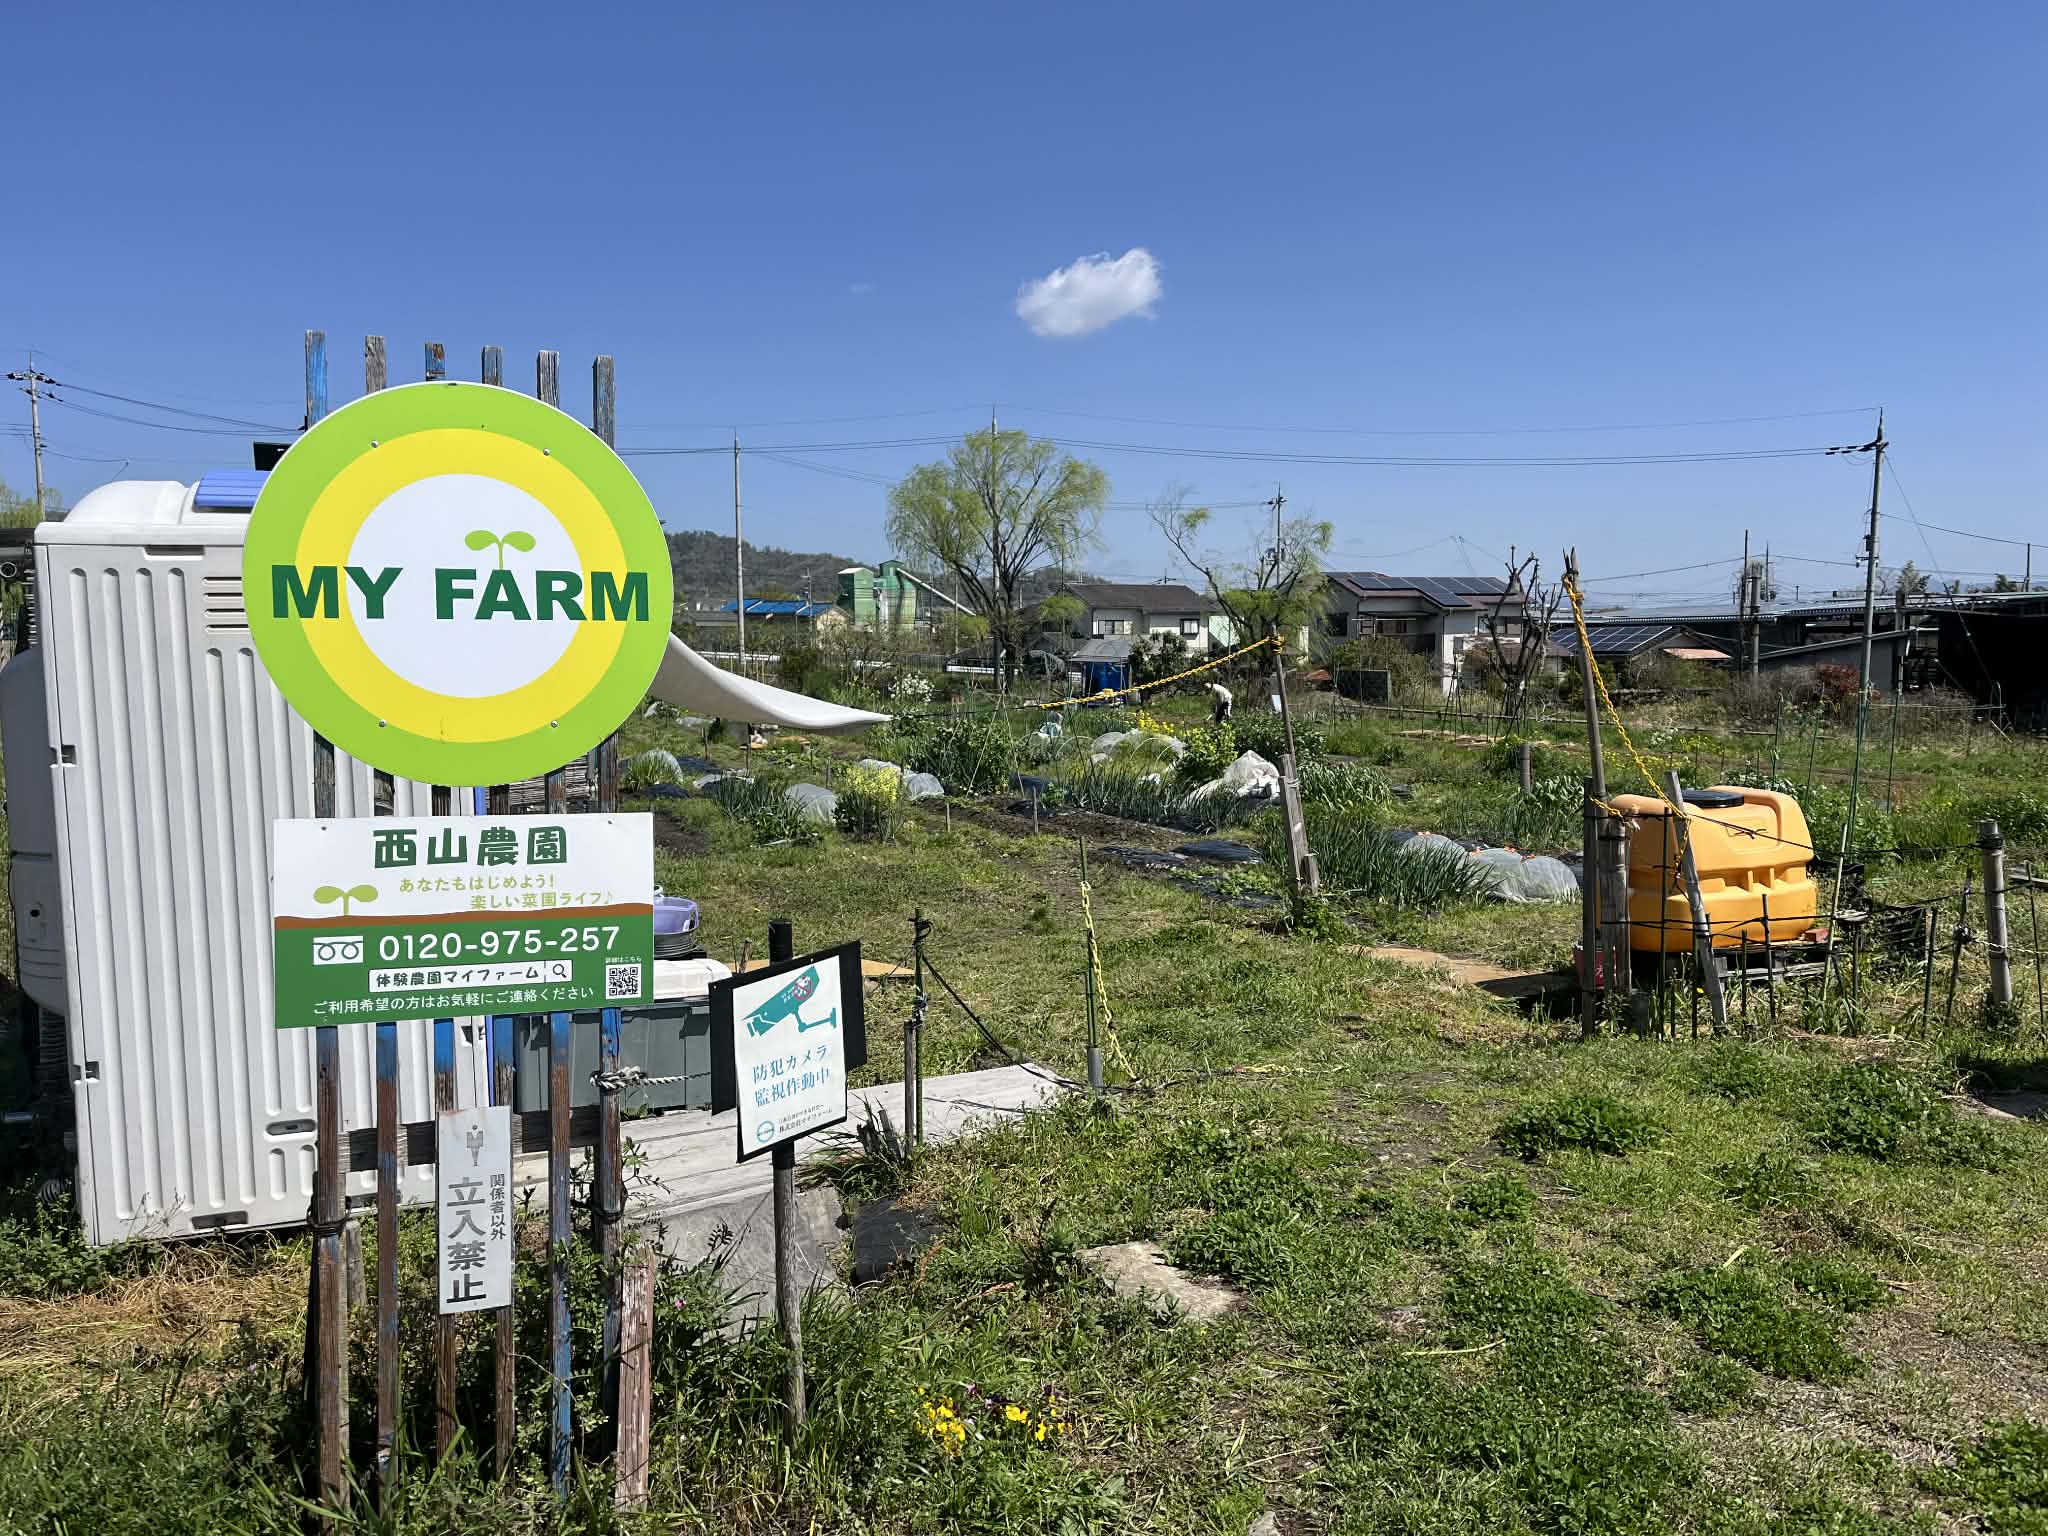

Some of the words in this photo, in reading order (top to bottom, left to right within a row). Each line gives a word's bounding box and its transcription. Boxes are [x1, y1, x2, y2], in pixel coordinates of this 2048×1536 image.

[271, 564, 404, 620] MY
[435, 567, 650, 622] FARM
[373, 825, 568, 869] 西山農園
[399, 874, 555, 893] あなたもはじめよう!
[378, 926, 622, 962] 0120-975-257
[375, 965, 540, 988] 体験農園マイファーム
[313, 986, 595, 1015] ご利用希望の方はお気軽にご連絡ください
[752, 1044, 829, 1083] 防犯カメラ
[754, 1067, 831, 1108] 監視作動中
[489, 1173, 506, 1241] 関係者以外
[446, 1176, 487, 1304] 立入禁止
